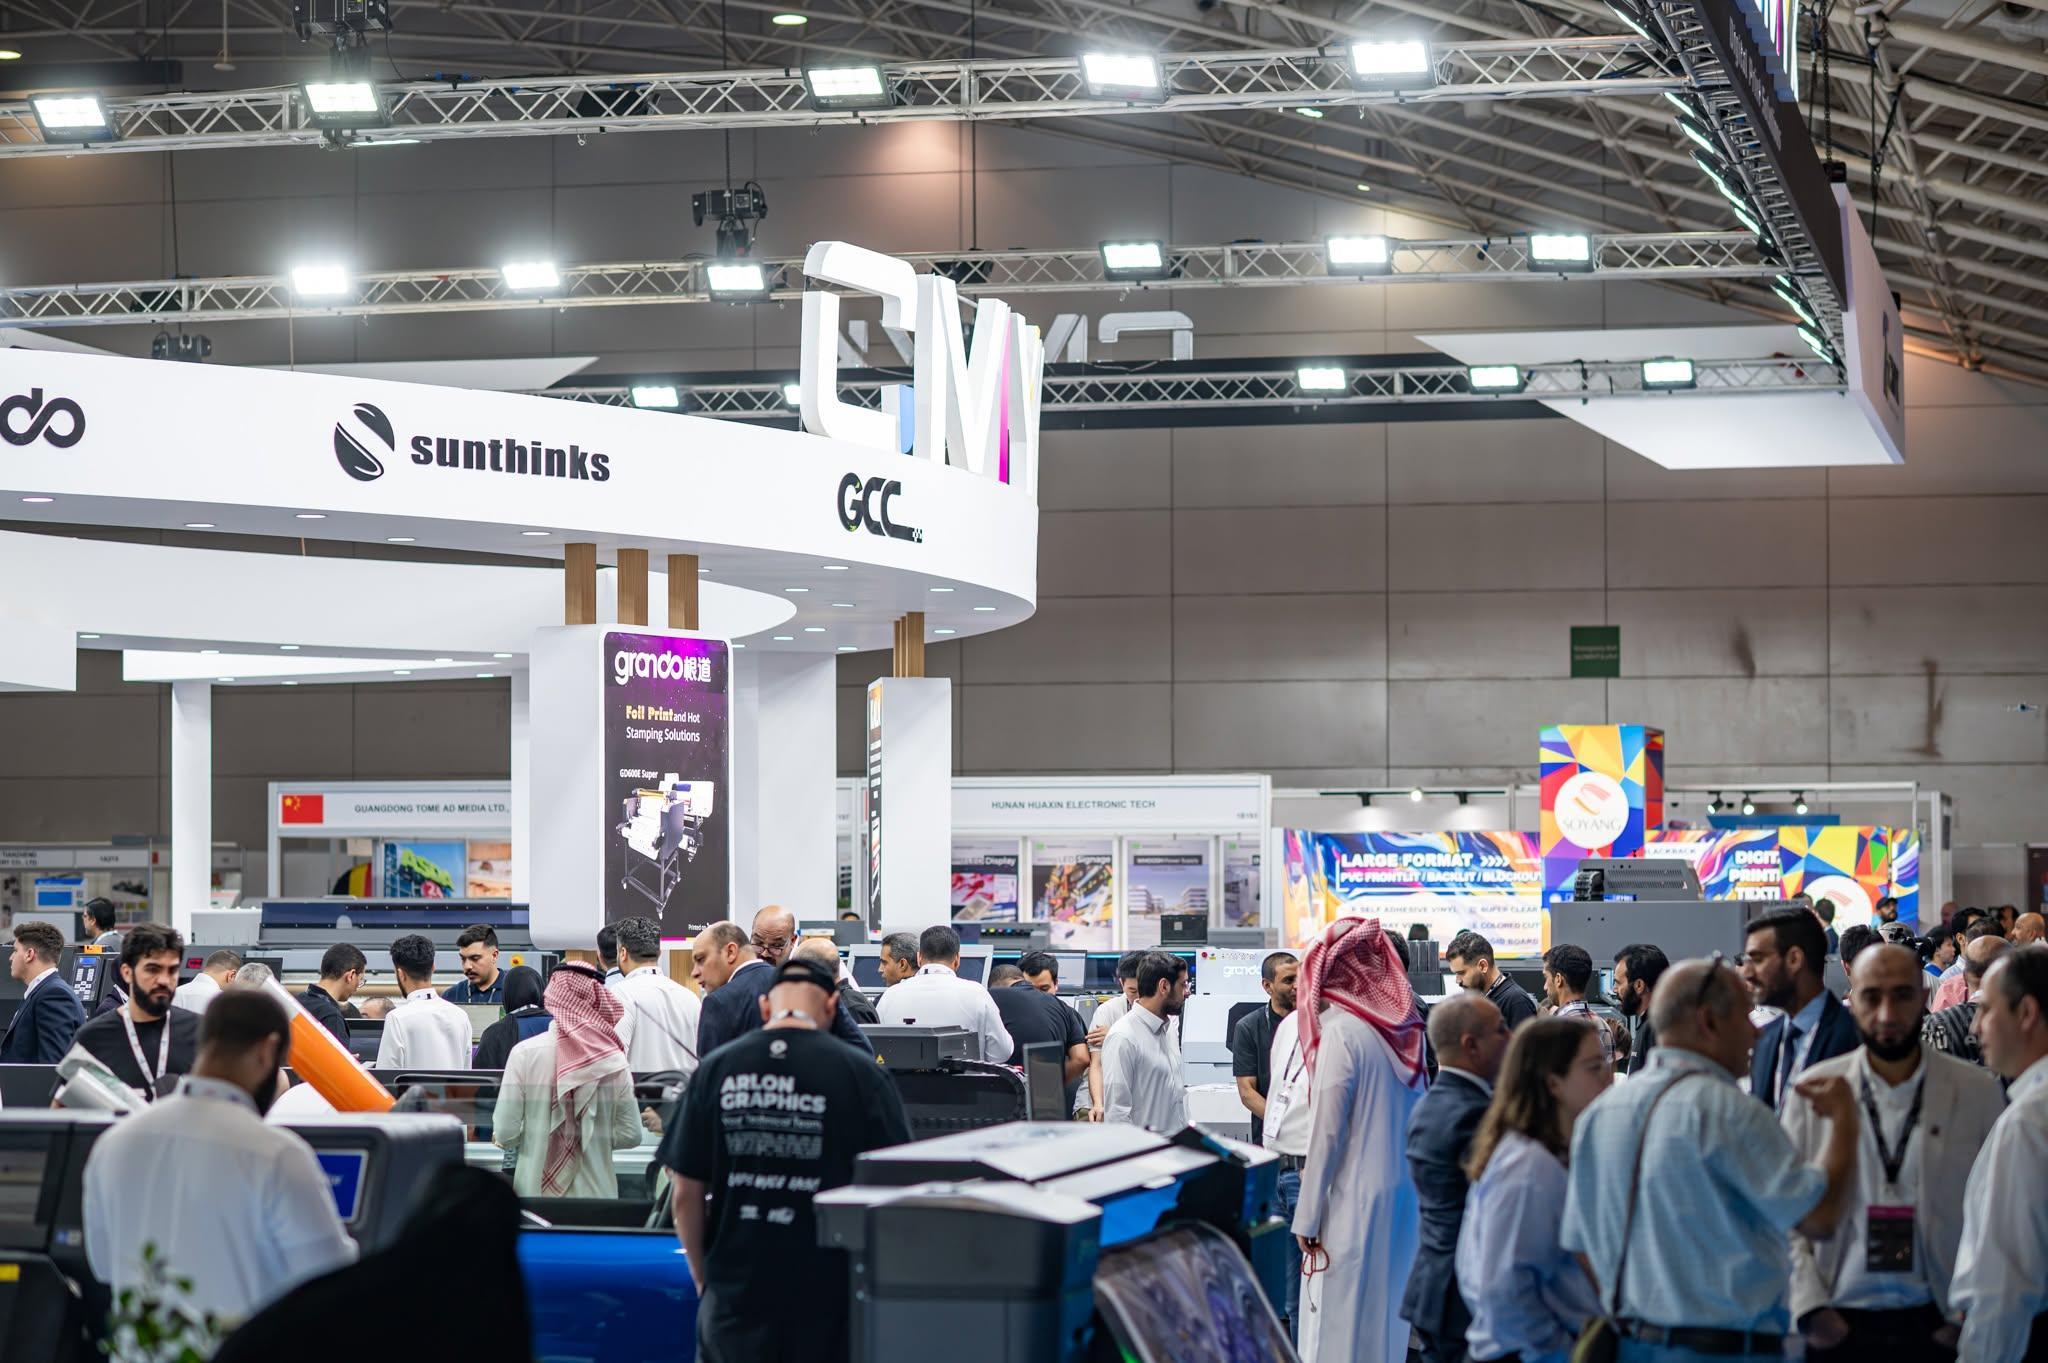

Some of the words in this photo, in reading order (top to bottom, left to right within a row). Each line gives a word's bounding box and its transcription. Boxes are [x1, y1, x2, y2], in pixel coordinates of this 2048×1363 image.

[411, 435, 610, 482] sunthinks
[838, 472, 922, 543] GCC
[615, 651, 683, 685] grando
[626, 705, 645, 720] Foil
[687, 712, 700, 723] Hot
[626, 727, 663, 743] Stamping
[664, 728, 700, 742] Solutions
[642, 770, 658, 780] Super
[354, 804, 413, 813] GUANGDONG
[416, 804, 440, 812] TOME
[443, 804, 456, 812] AD
[457, 804, 486, 812] MEDIA
[991, 801, 1026, 809] HUNAN
[1027, 801, 1064, 809] HUAXIN
[1066, 800, 1127, 809] ELECTRONIC
[1130, 800, 1156, 809] TECH
[1563, 817, 1622, 832] SOYANG
[985, 856, 1016, 866] Display
[1076, 856, 1111, 866] Signage
[1341, 853, 1398, 868] LARGE
[1401, 853, 1473, 868] FORMAT
[1735, 849, 1780, 865] DIGIT
[1340, 871, 1365, 883] PVC
[1365, 871, 1422, 883] FRONTLIT
[1427, 871, 1477, 883] BACKLIT
[720, 1073, 795, 1094] ARLON
[720, 1092, 827, 1113] GRAPHICS
